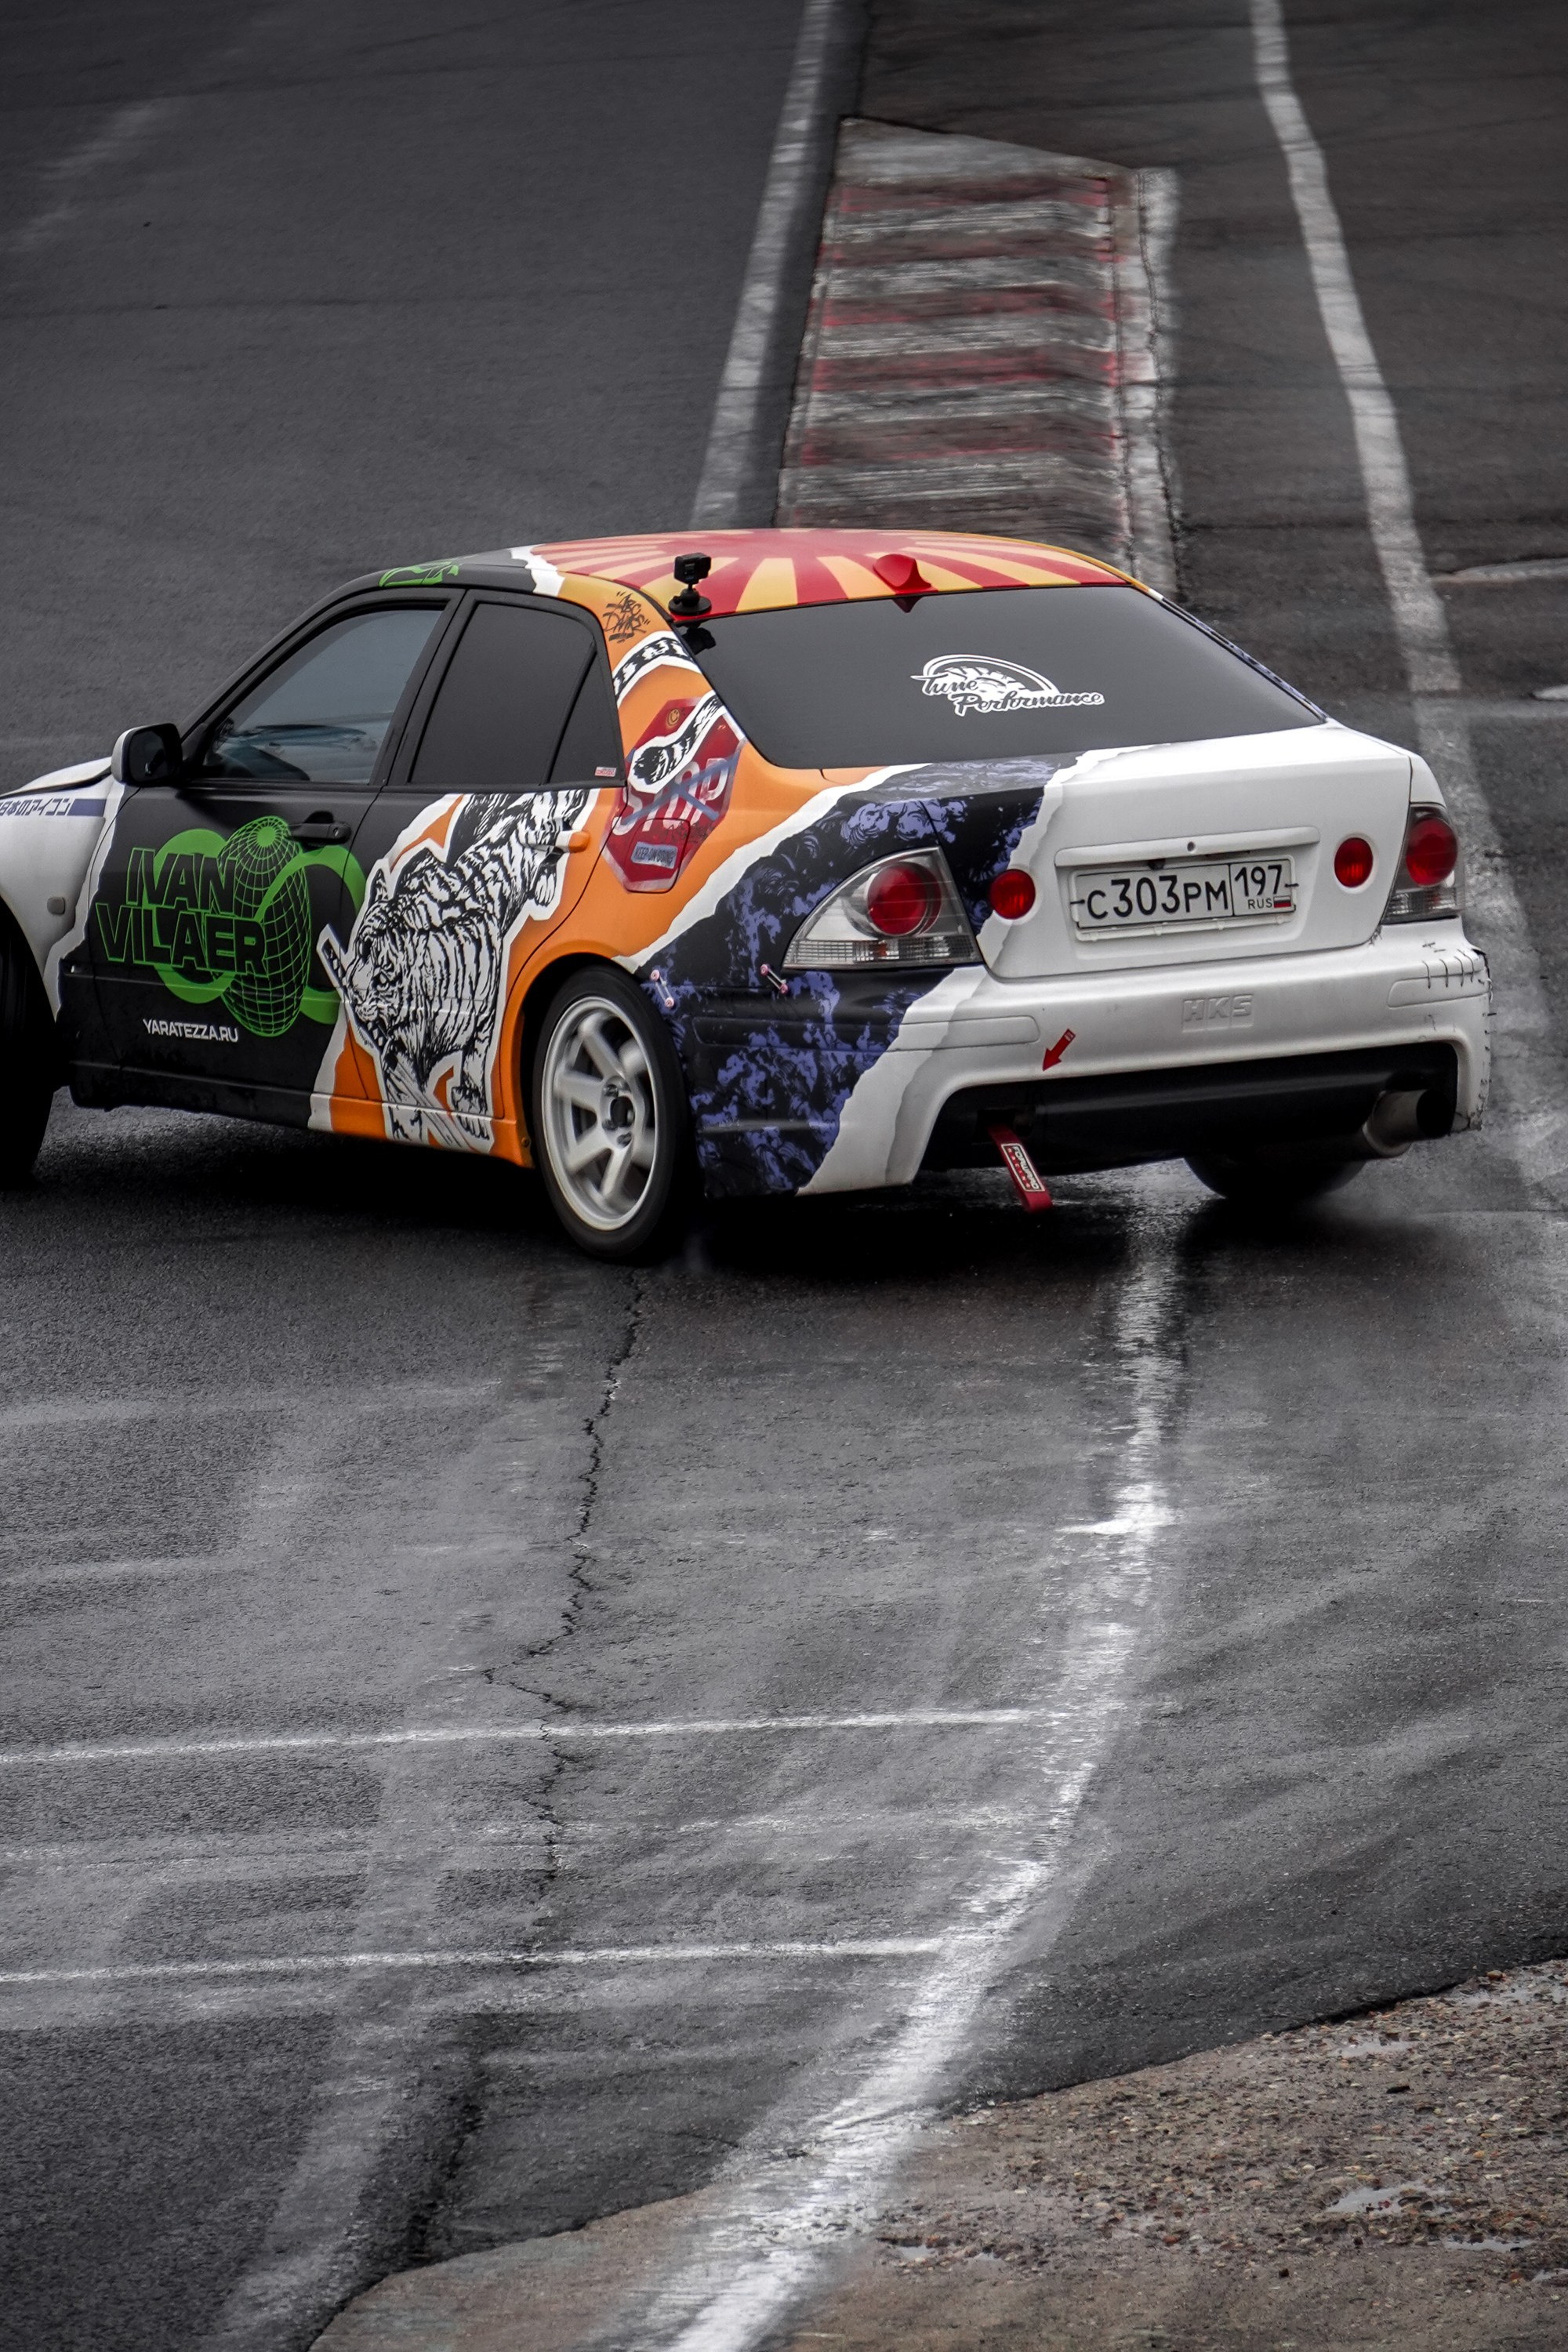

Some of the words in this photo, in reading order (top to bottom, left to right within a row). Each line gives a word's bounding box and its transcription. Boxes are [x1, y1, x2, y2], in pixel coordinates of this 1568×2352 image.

[912, 672, 979, 695] Tune
[949, 690, 1104, 716] Performance
[126, 847, 237, 916] IVAN
[1235, 864, 1283, 898] 197
[1248, 898, 1273, 910] RUS
[96, 902, 269, 979] VILAER
[1183, 994, 1254, 1023] HKS
[143, 1018, 239, 1043] YARATEZZA.RU
